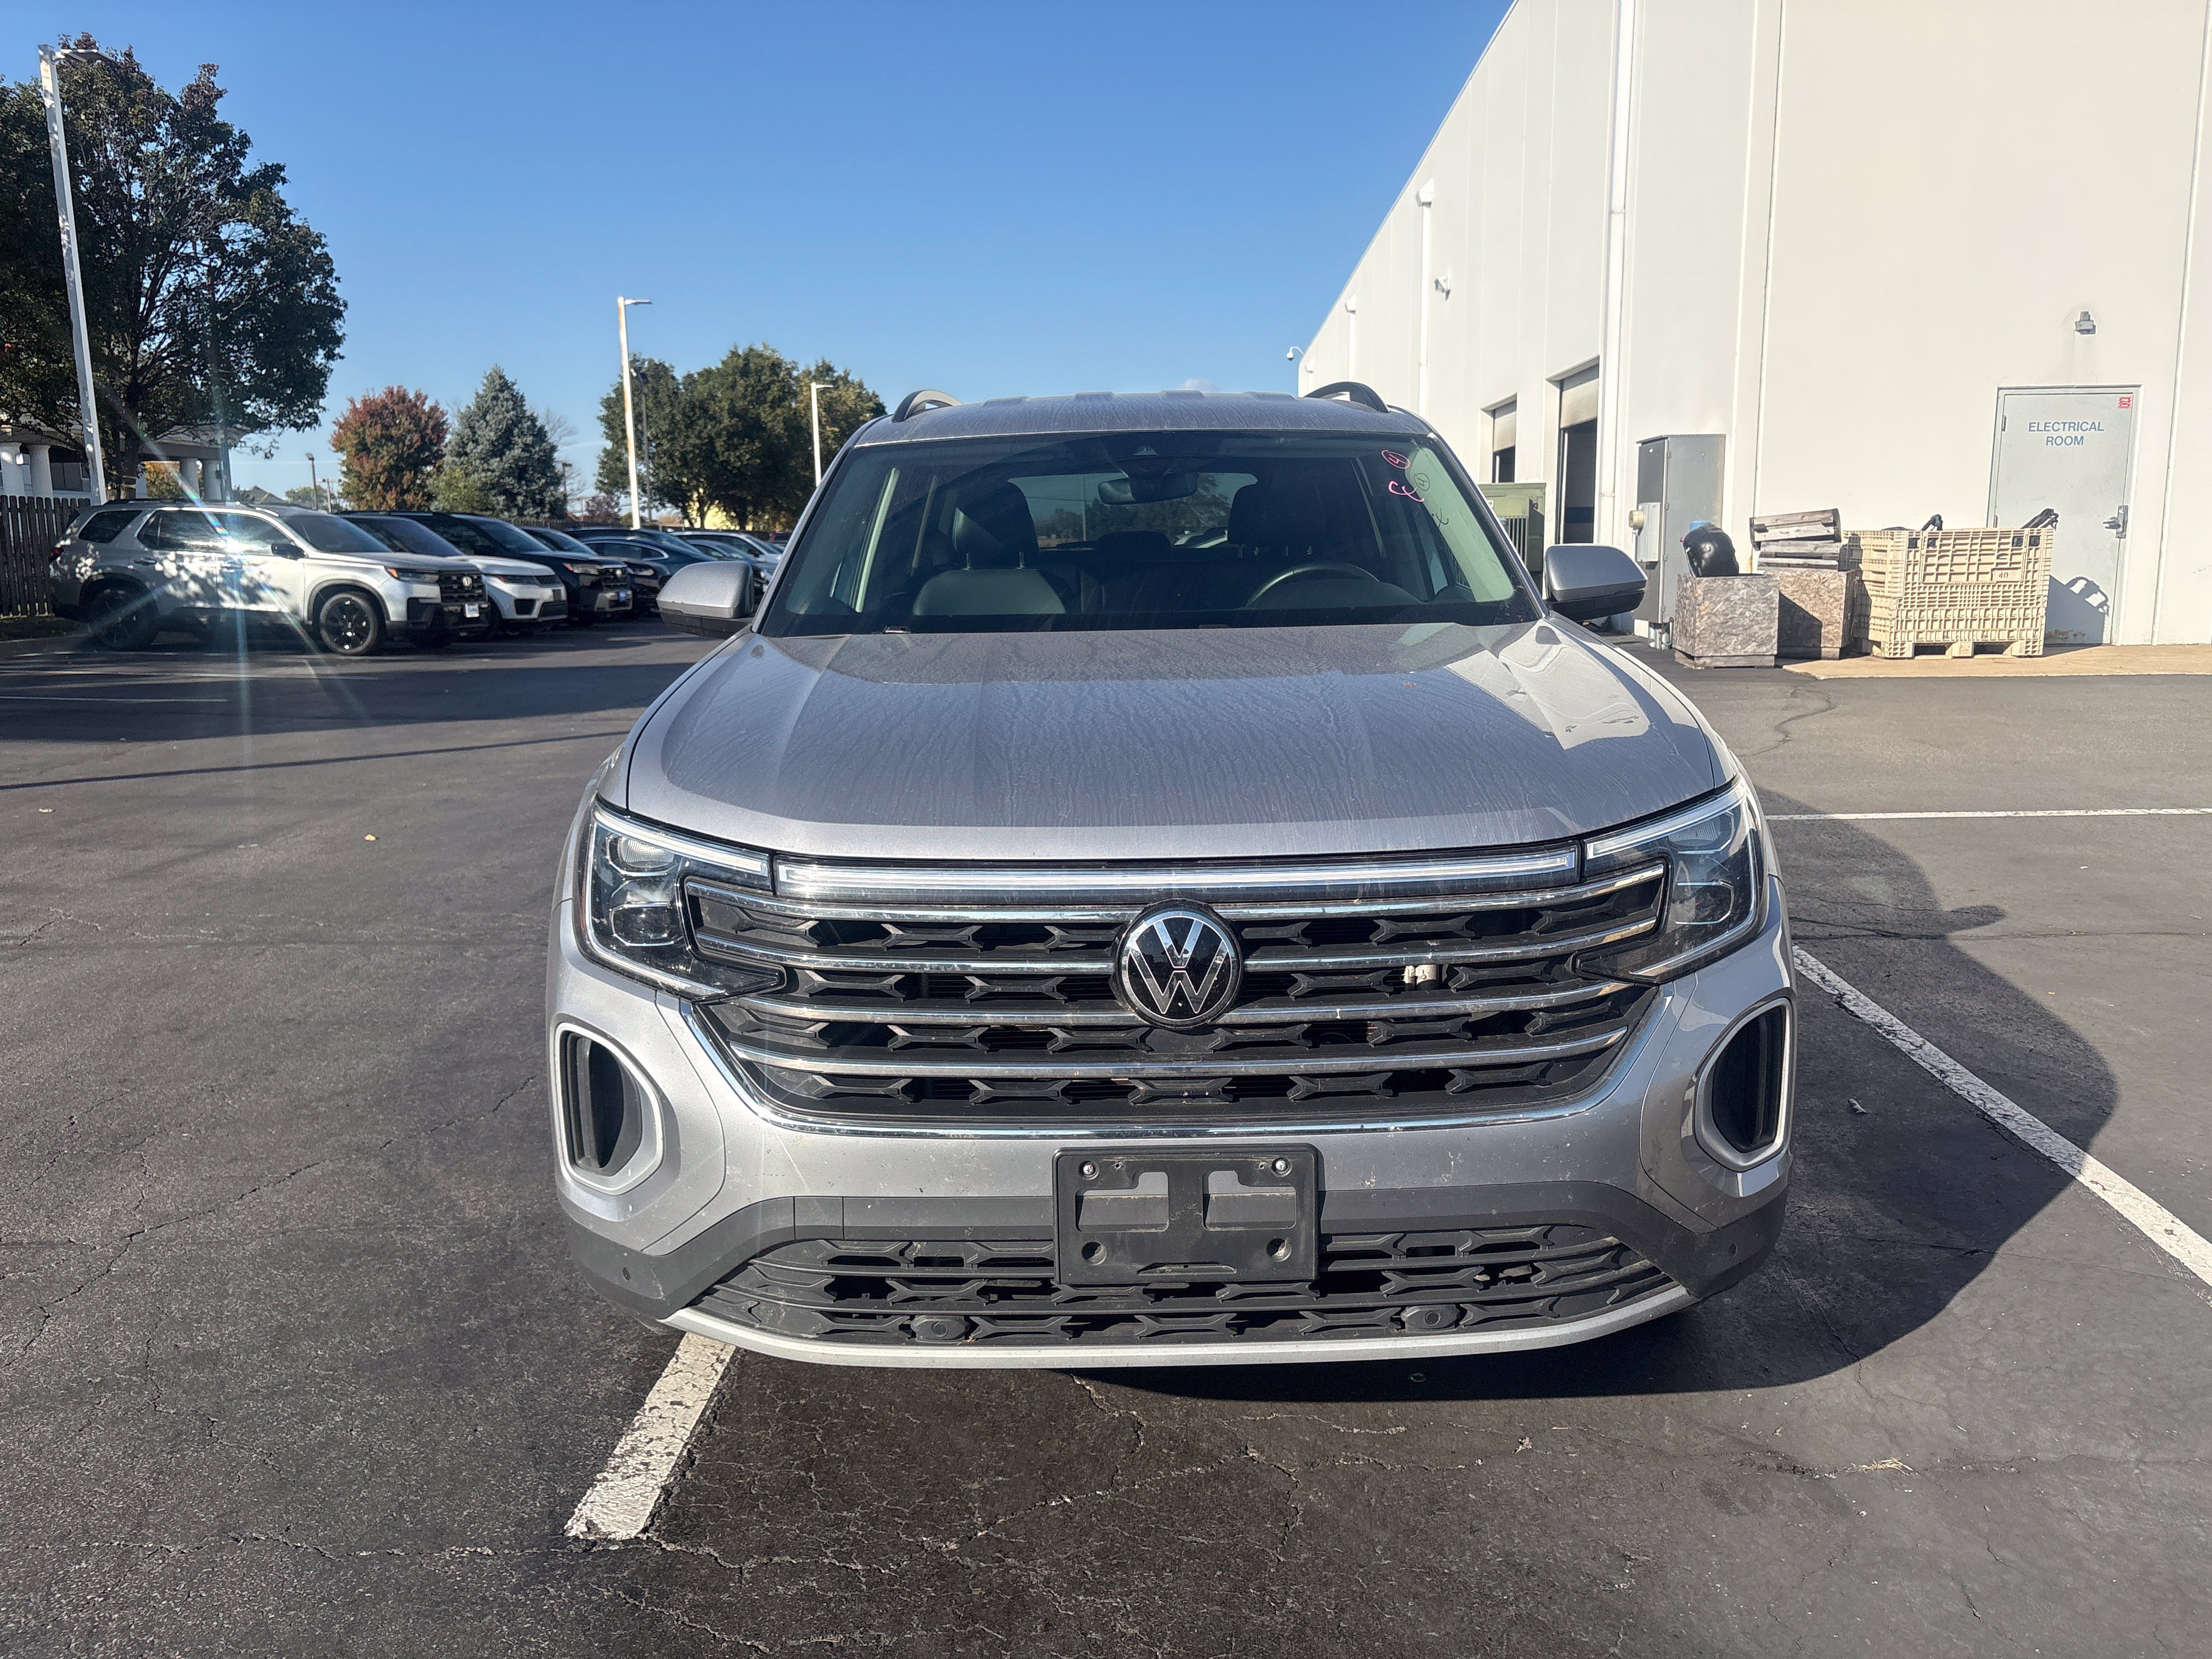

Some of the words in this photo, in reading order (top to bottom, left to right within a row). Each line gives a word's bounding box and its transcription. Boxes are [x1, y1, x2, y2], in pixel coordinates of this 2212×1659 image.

[2028, 421, 2104, 432] ELECTRICAL
[2046, 436, 2084, 446] ROOM
[1129, 918, 1229, 1015] VW
